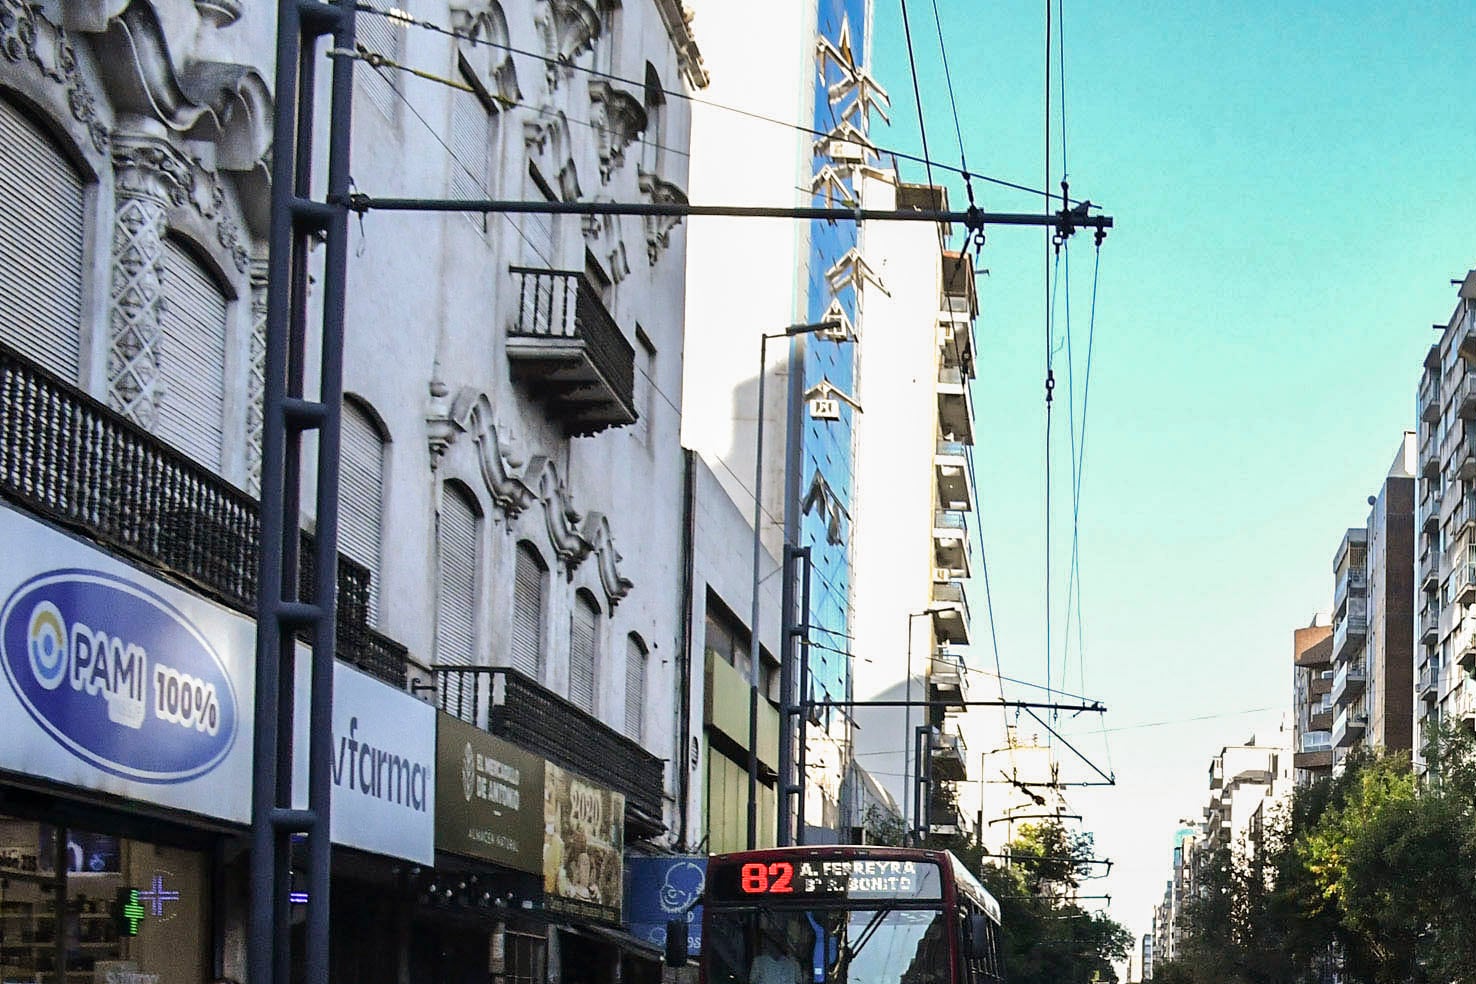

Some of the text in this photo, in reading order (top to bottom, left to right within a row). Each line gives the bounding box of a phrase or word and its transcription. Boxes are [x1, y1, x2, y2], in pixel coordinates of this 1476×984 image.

[74, 630, 217, 729] PAMI 100%
[741, 862, 794, 893] 82
[823, 861, 916, 876] FERREYRA
[848, 877, 912, 892] BONITO
